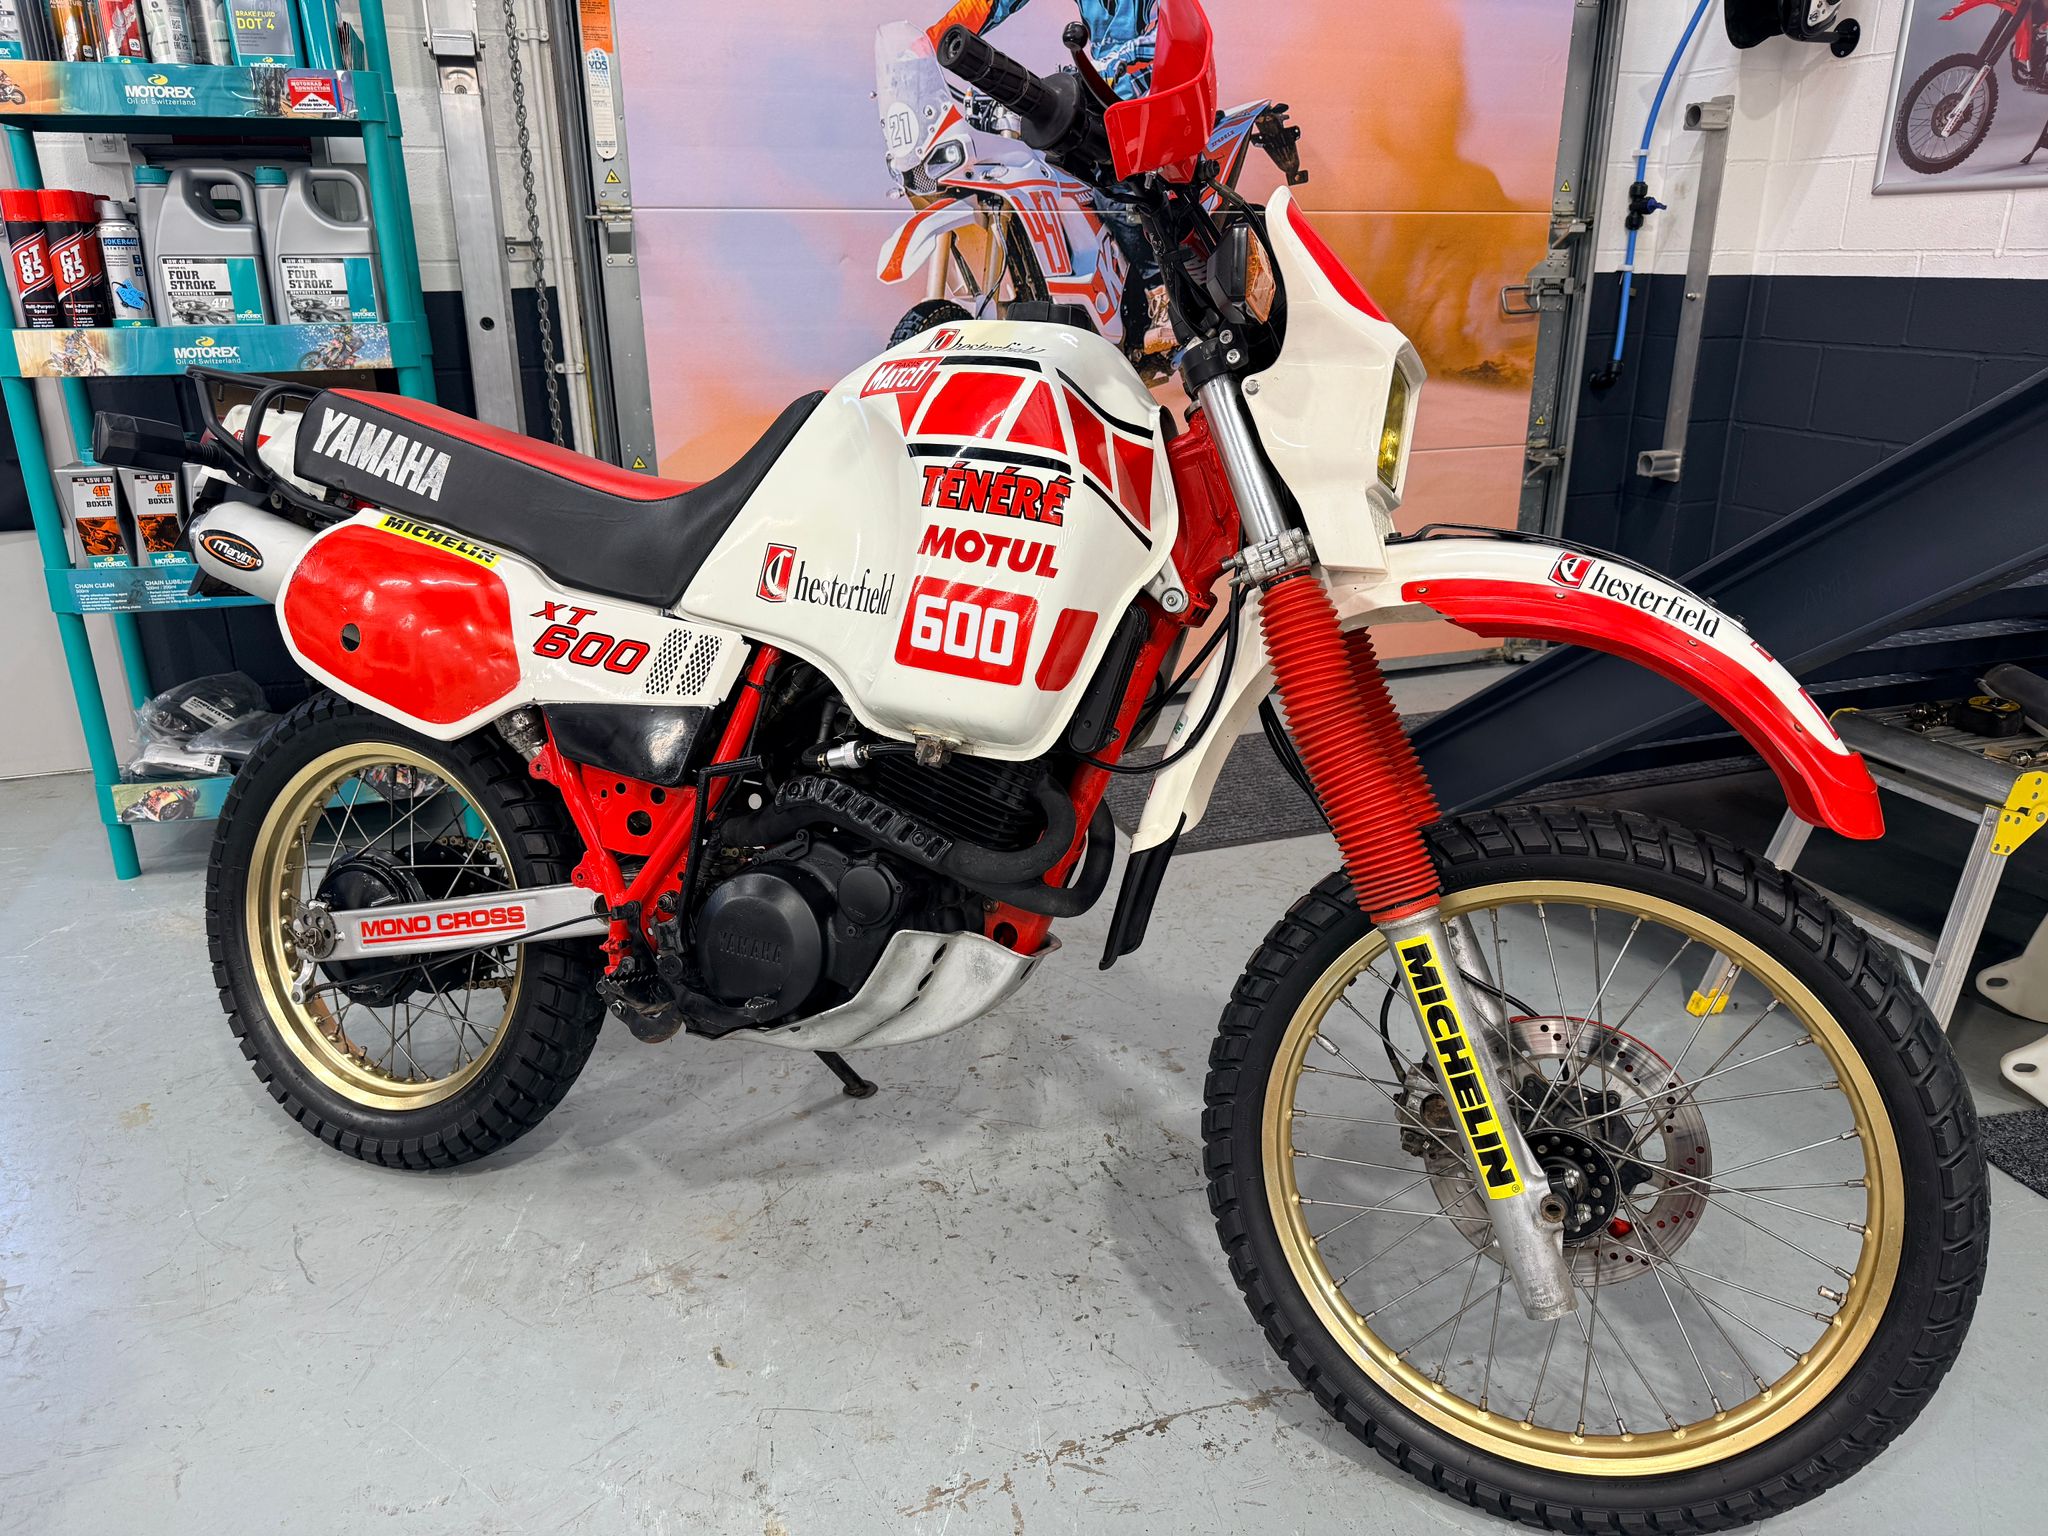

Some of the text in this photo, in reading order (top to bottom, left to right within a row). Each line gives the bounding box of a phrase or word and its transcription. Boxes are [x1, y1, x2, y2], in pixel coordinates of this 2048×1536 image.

[237, 18, 275, 30] DOT 4
[588, 60, 608, 70] YDS
[125, 85, 194, 99] MOTOREX
[140, 97, 149, 105] of
[151, 98, 197, 106] Switzerland
[888, 111, 913, 149] 21
[19, 243, 40, 267] GT
[60, 243, 81, 267] GT
[21, 258, 45, 284] 85
[62, 258, 86, 284] 85
[168, 270, 200, 280] FOUR
[287, 269, 318, 279] FOUR
[170, 280, 217, 290] STROKE
[288, 279, 333, 289] STROKE
[211, 297, 229, 309] 4T
[328, 296, 345, 307] 4T
[173, 346, 240, 359] MOTOREX
[198, 357, 241, 365] Switzerland
[864, 360, 934, 393] MATCH
[312, 406, 452, 502] YAMAHA
[92, 485, 111, 497] 4T
[154, 482, 172, 495] 4T
[920, 460, 1076, 527] TÉNÉRÉ
[86, 500, 113, 508] BOXER
[148, 497, 174, 505] BOXER
[384, 515, 497, 564] MICHELIN
[154, 556, 187, 566] MOTOREX
[917, 524, 1059, 579] MOTUL
[93, 560, 127, 569] MOTOREX
[756, 543, 896, 616] Chesterfield
[1548, 551, 1721, 640] Chesterfield
[529, 600, 598, 627] XT
[909, 593, 1020, 667] 600
[533, 623, 651, 675] 600
[361, 905, 527, 938] MONO CROSS
[718, 930, 782, 966] YAMAHA
[1400, 942, 1516, 1188] MICHELIN
